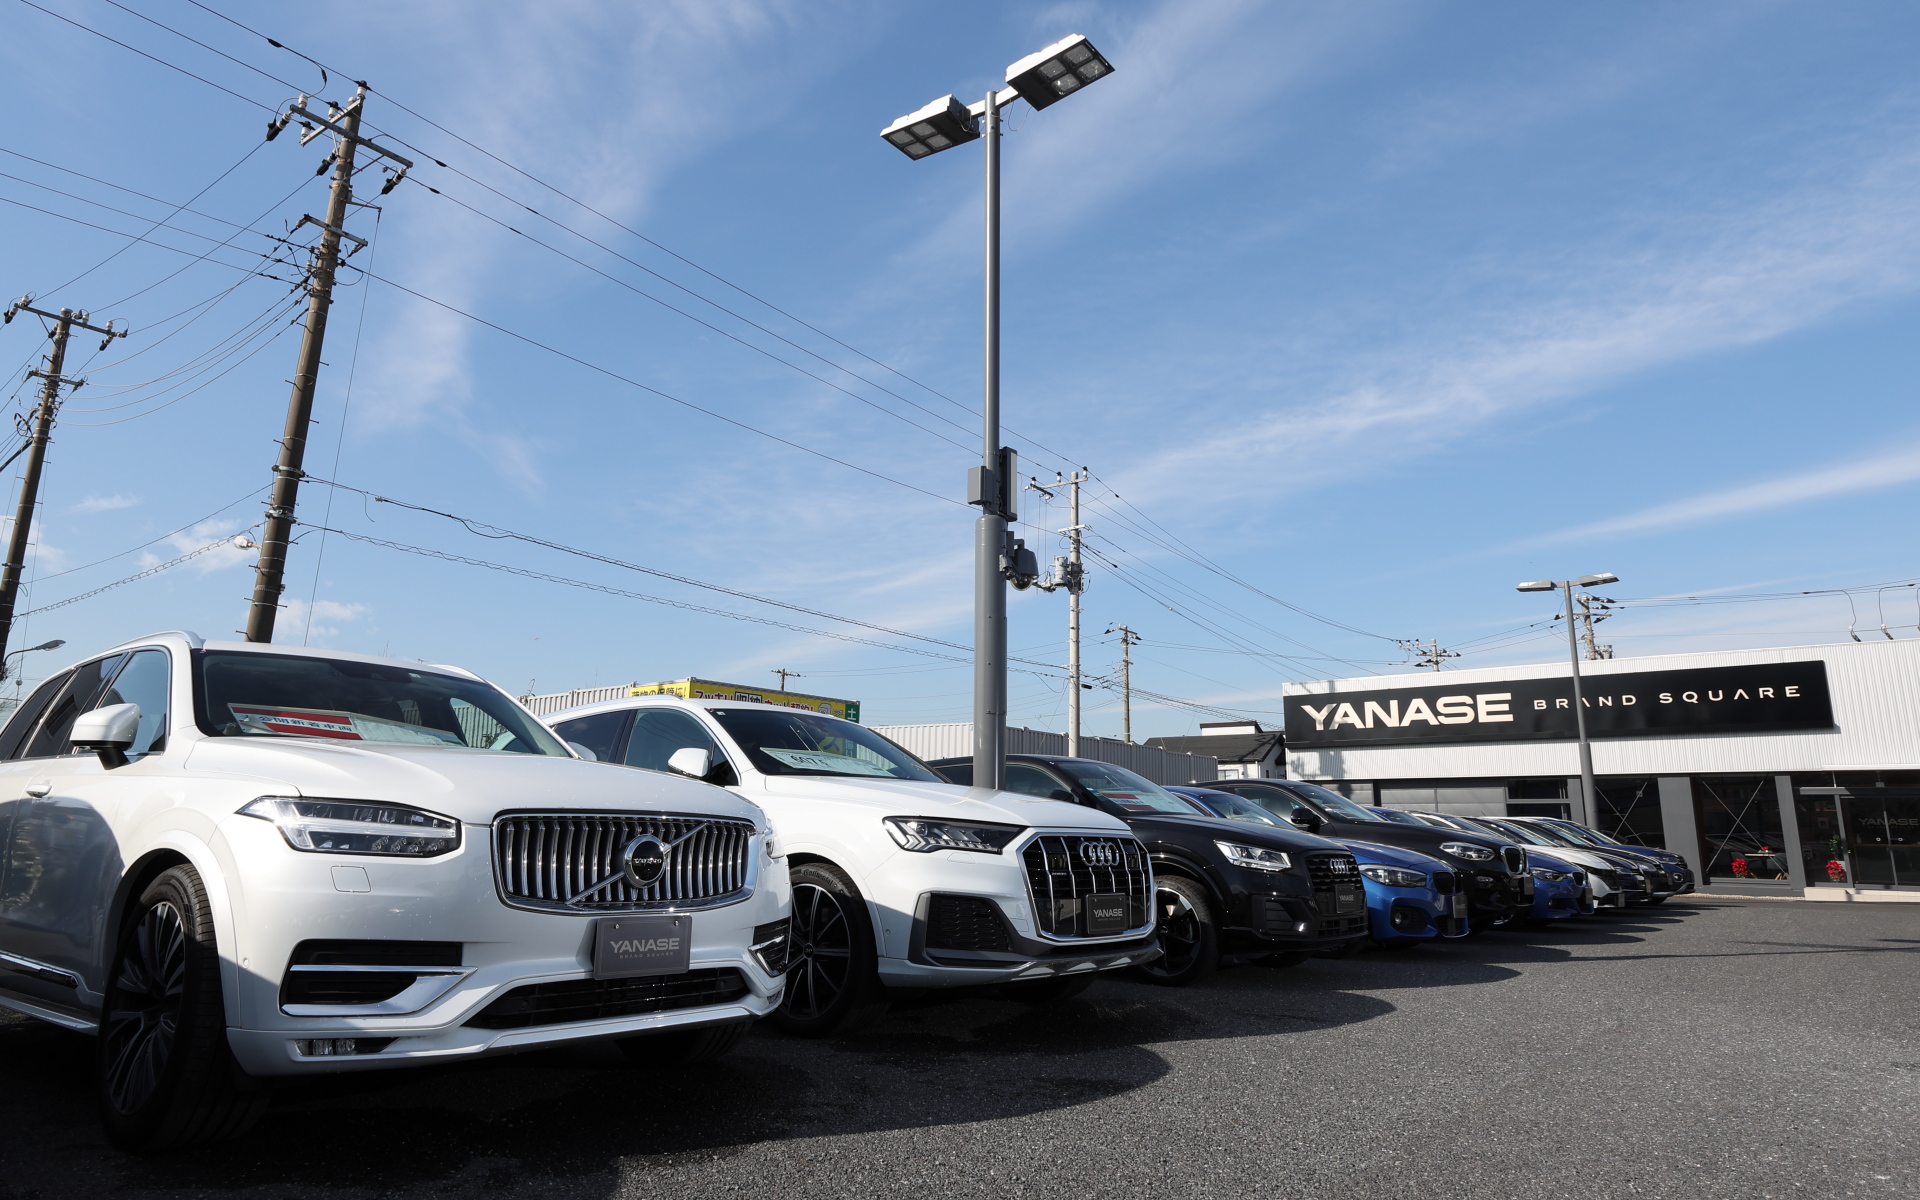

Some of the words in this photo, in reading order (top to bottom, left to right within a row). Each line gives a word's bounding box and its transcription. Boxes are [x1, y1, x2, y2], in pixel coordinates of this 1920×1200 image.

[1301, 692, 1514, 731] YANASE
[1659, 685, 1801, 704] SQUARE
[1093, 908, 1123, 918] YANASE
[610, 937, 680, 954] YANASE
